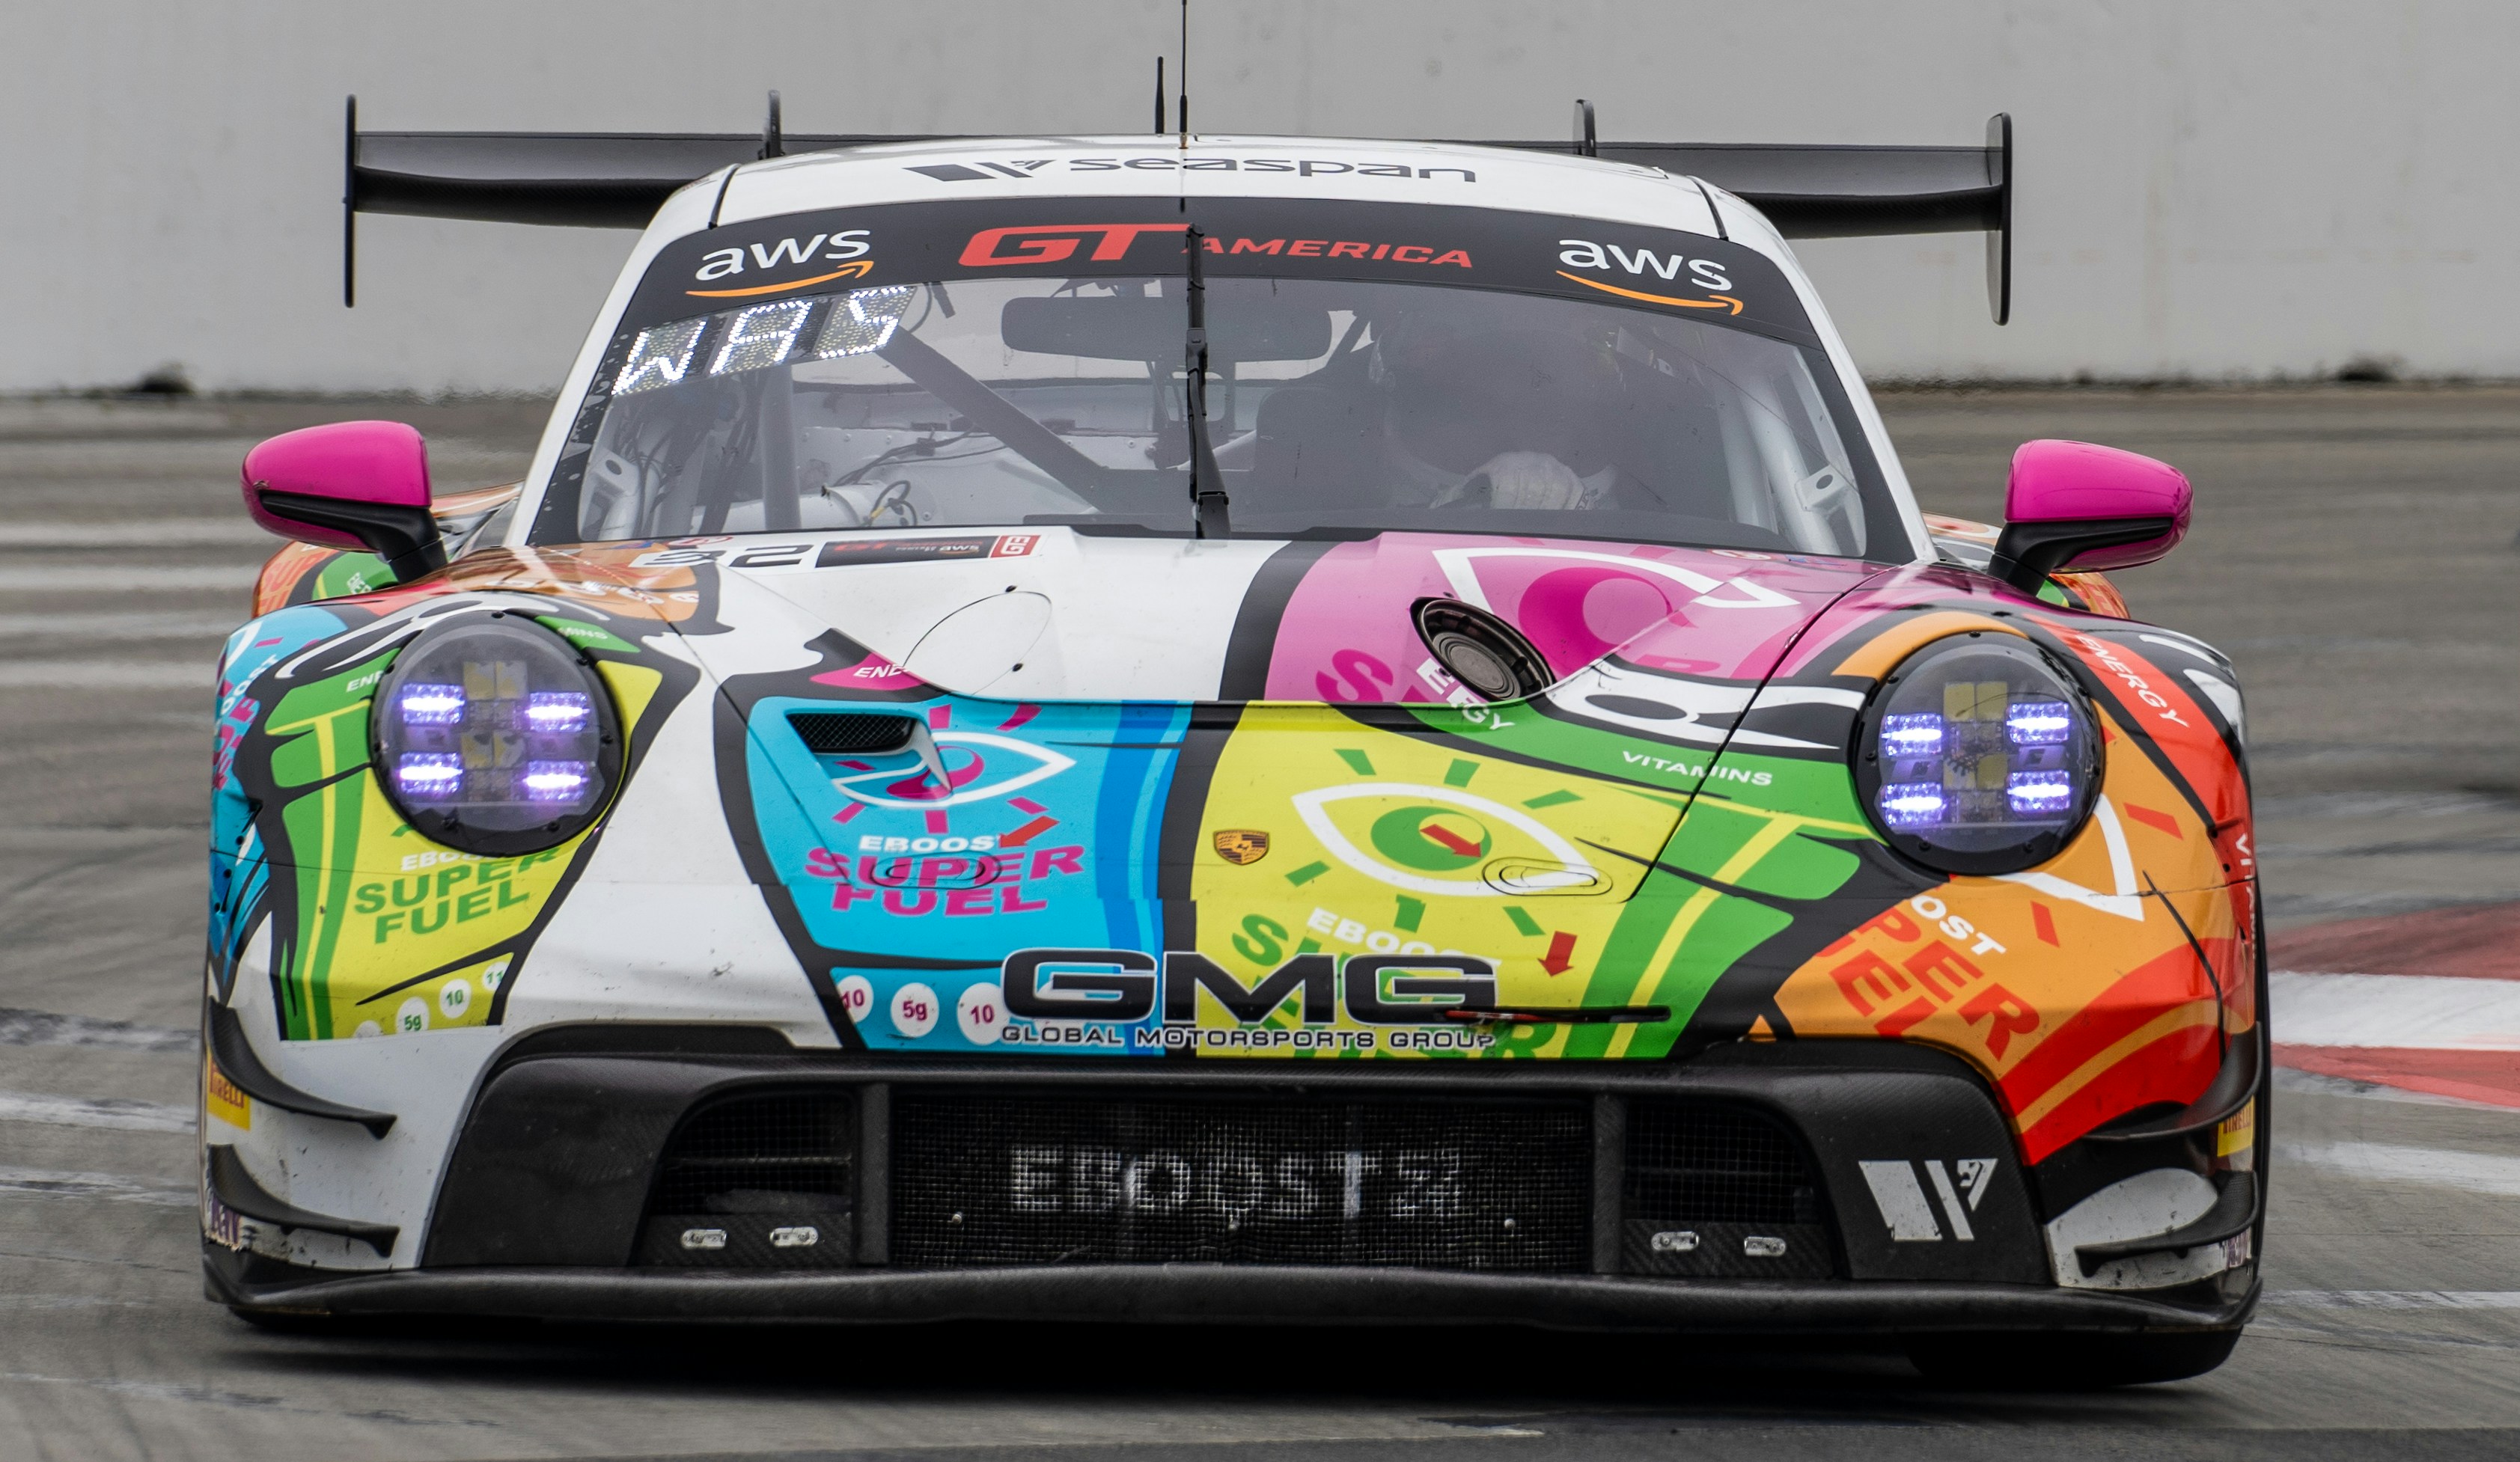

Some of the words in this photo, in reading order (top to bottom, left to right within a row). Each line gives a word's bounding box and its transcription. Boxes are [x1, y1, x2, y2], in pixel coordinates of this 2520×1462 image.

[1069, 158, 1477, 183] seaspan
[695, 230, 871, 281] aws
[959, 223, 1194, 267] GT
[1181, 236, 1473, 269] AMERICA
[1558, 239, 1733, 291] aws
[2075, 634, 2190, 728] ENERGY
[1622, 750, 1773, 786] VITAMINS
[858, 835, 1001, 853] EBOOS
[354, 847, 561, 914] SUPER
[805, 845, 1085, 889] SUPER
[374, 879, 531, 944] FUEL
[831, 884, 1048, 917] FUEL
[1910, 895, 2007, 955] OST
[446, 988, 464, 1006] 10
[1001, 948, 1498, 1027] GMG
[1817, 906, 2040, 1063] PER
[403, 1013, 423, 1032] 5g
[902, 999, 929, 1021] 5g
[970, 1003, 995, 1024] 10
[1001, 1026, 1123, 1047] GLOBAL
[1136, 1027, 1375, 1049] MOTORSPORTS
[1390, 1029, 1496, 1051] GROUP
[1010, 1146, 1382, 1218] EBOOST
